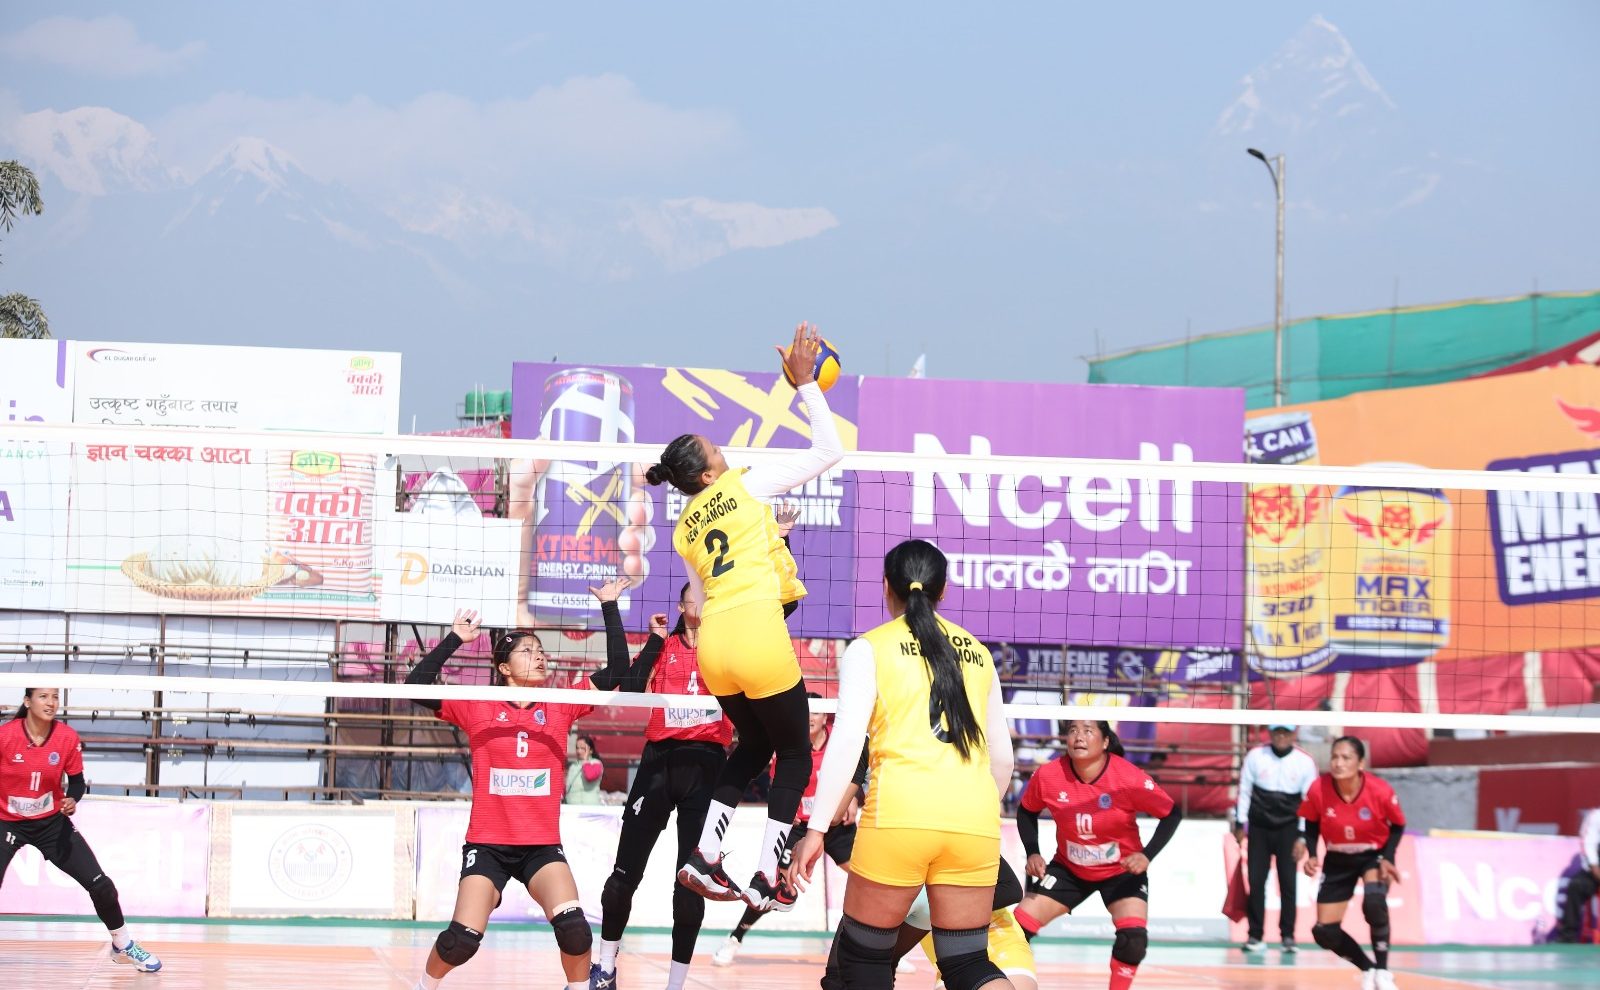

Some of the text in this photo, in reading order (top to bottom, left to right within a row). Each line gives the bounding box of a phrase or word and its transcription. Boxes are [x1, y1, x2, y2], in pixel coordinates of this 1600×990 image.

[89, 397, 139, 414] उत्कृष्ट
[201, 401, 239, 413] तयार
[86, 444, 128, 461] ज्ञान
[200, 447, 251, 464] आटा
[912, 433, 1194, 533] Ncell
[274, 486, 362, 517] चक्की
[703, 491, 723, 510] TOP
[1497, 461, 1600, 544] MA
[700, 496, 738, 529] DIAMOND
[286, 518, 364, 544] आटा
[704, 529, 735, 577] 2
[431, 563, 504, 577] DARSHAN
[538, 563, 579, 575] ENERGY
[582, 565, 616, 576] DRINK
[1357, 576, 1430, 599] MAX
[551, 595, 590, 607] CLASSIC
[1357, 600, 1430, 613] TIGER
[951, 635, 972, 648] OP
[954, 647, 983, 668] MOND
[1028, 650, 1109, 675] XTREME
[686, 671, 699, 695] 4
[516, 731, 528, 758] 6
[30, 771, 41, 791] 11
[492, 774, 534, 789] RUPSE
[632, 796, 645, 816] 4
[1075, 813, 1093, 835] 10
[465, 849, 478, 868] 6
